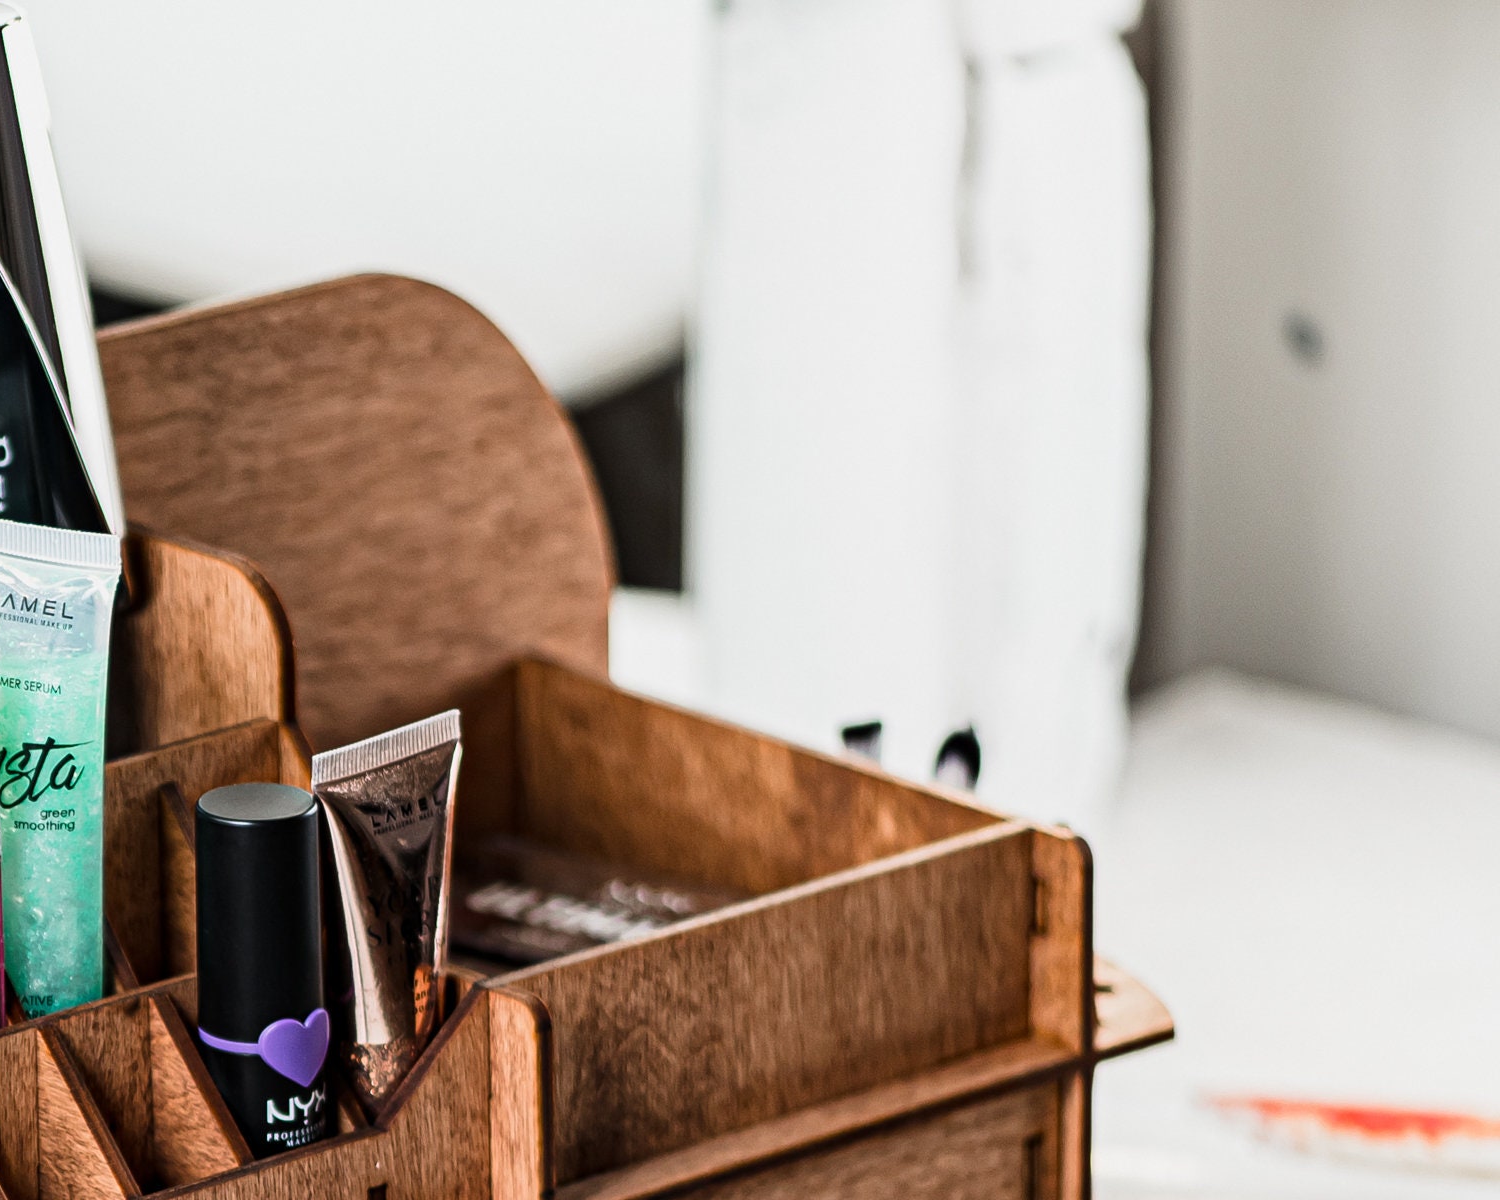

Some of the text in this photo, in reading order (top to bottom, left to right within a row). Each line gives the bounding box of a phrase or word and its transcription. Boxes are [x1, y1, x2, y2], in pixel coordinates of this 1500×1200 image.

[40, 619, 60, 630] MAKE
[62, 623, 73, 631] UP
[23, 680, 62, 695] SERUM
[40, 808, 76, 820] green
[371, 794, 443, 828] LAMEL
[13, 820, 76, 833] smoothing
[266, 1082, 327, 1126] NYX
